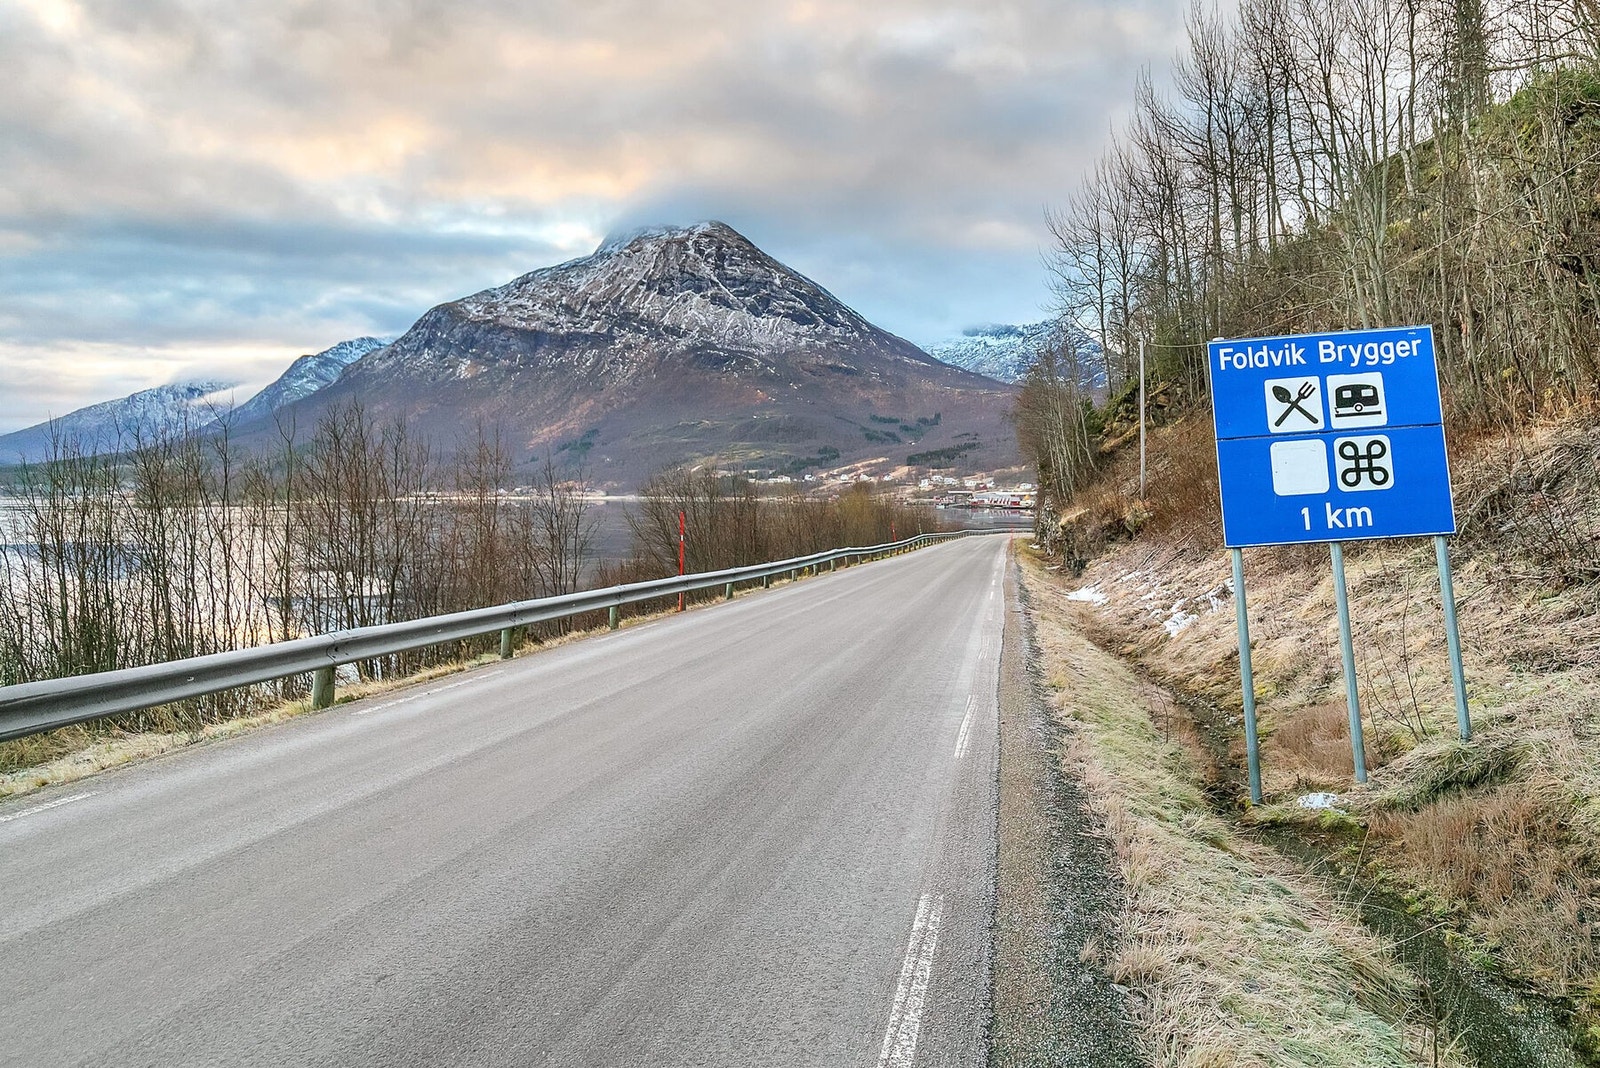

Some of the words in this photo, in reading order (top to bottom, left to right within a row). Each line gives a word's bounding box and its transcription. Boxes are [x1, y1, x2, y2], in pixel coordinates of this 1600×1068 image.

[1219, 343, 1306, 370] Foldvik
[1318, 339, 1421, 367] Brygger
[1301, 507, 1311, 531] 1
[1325, 502, 1373, 529] km
